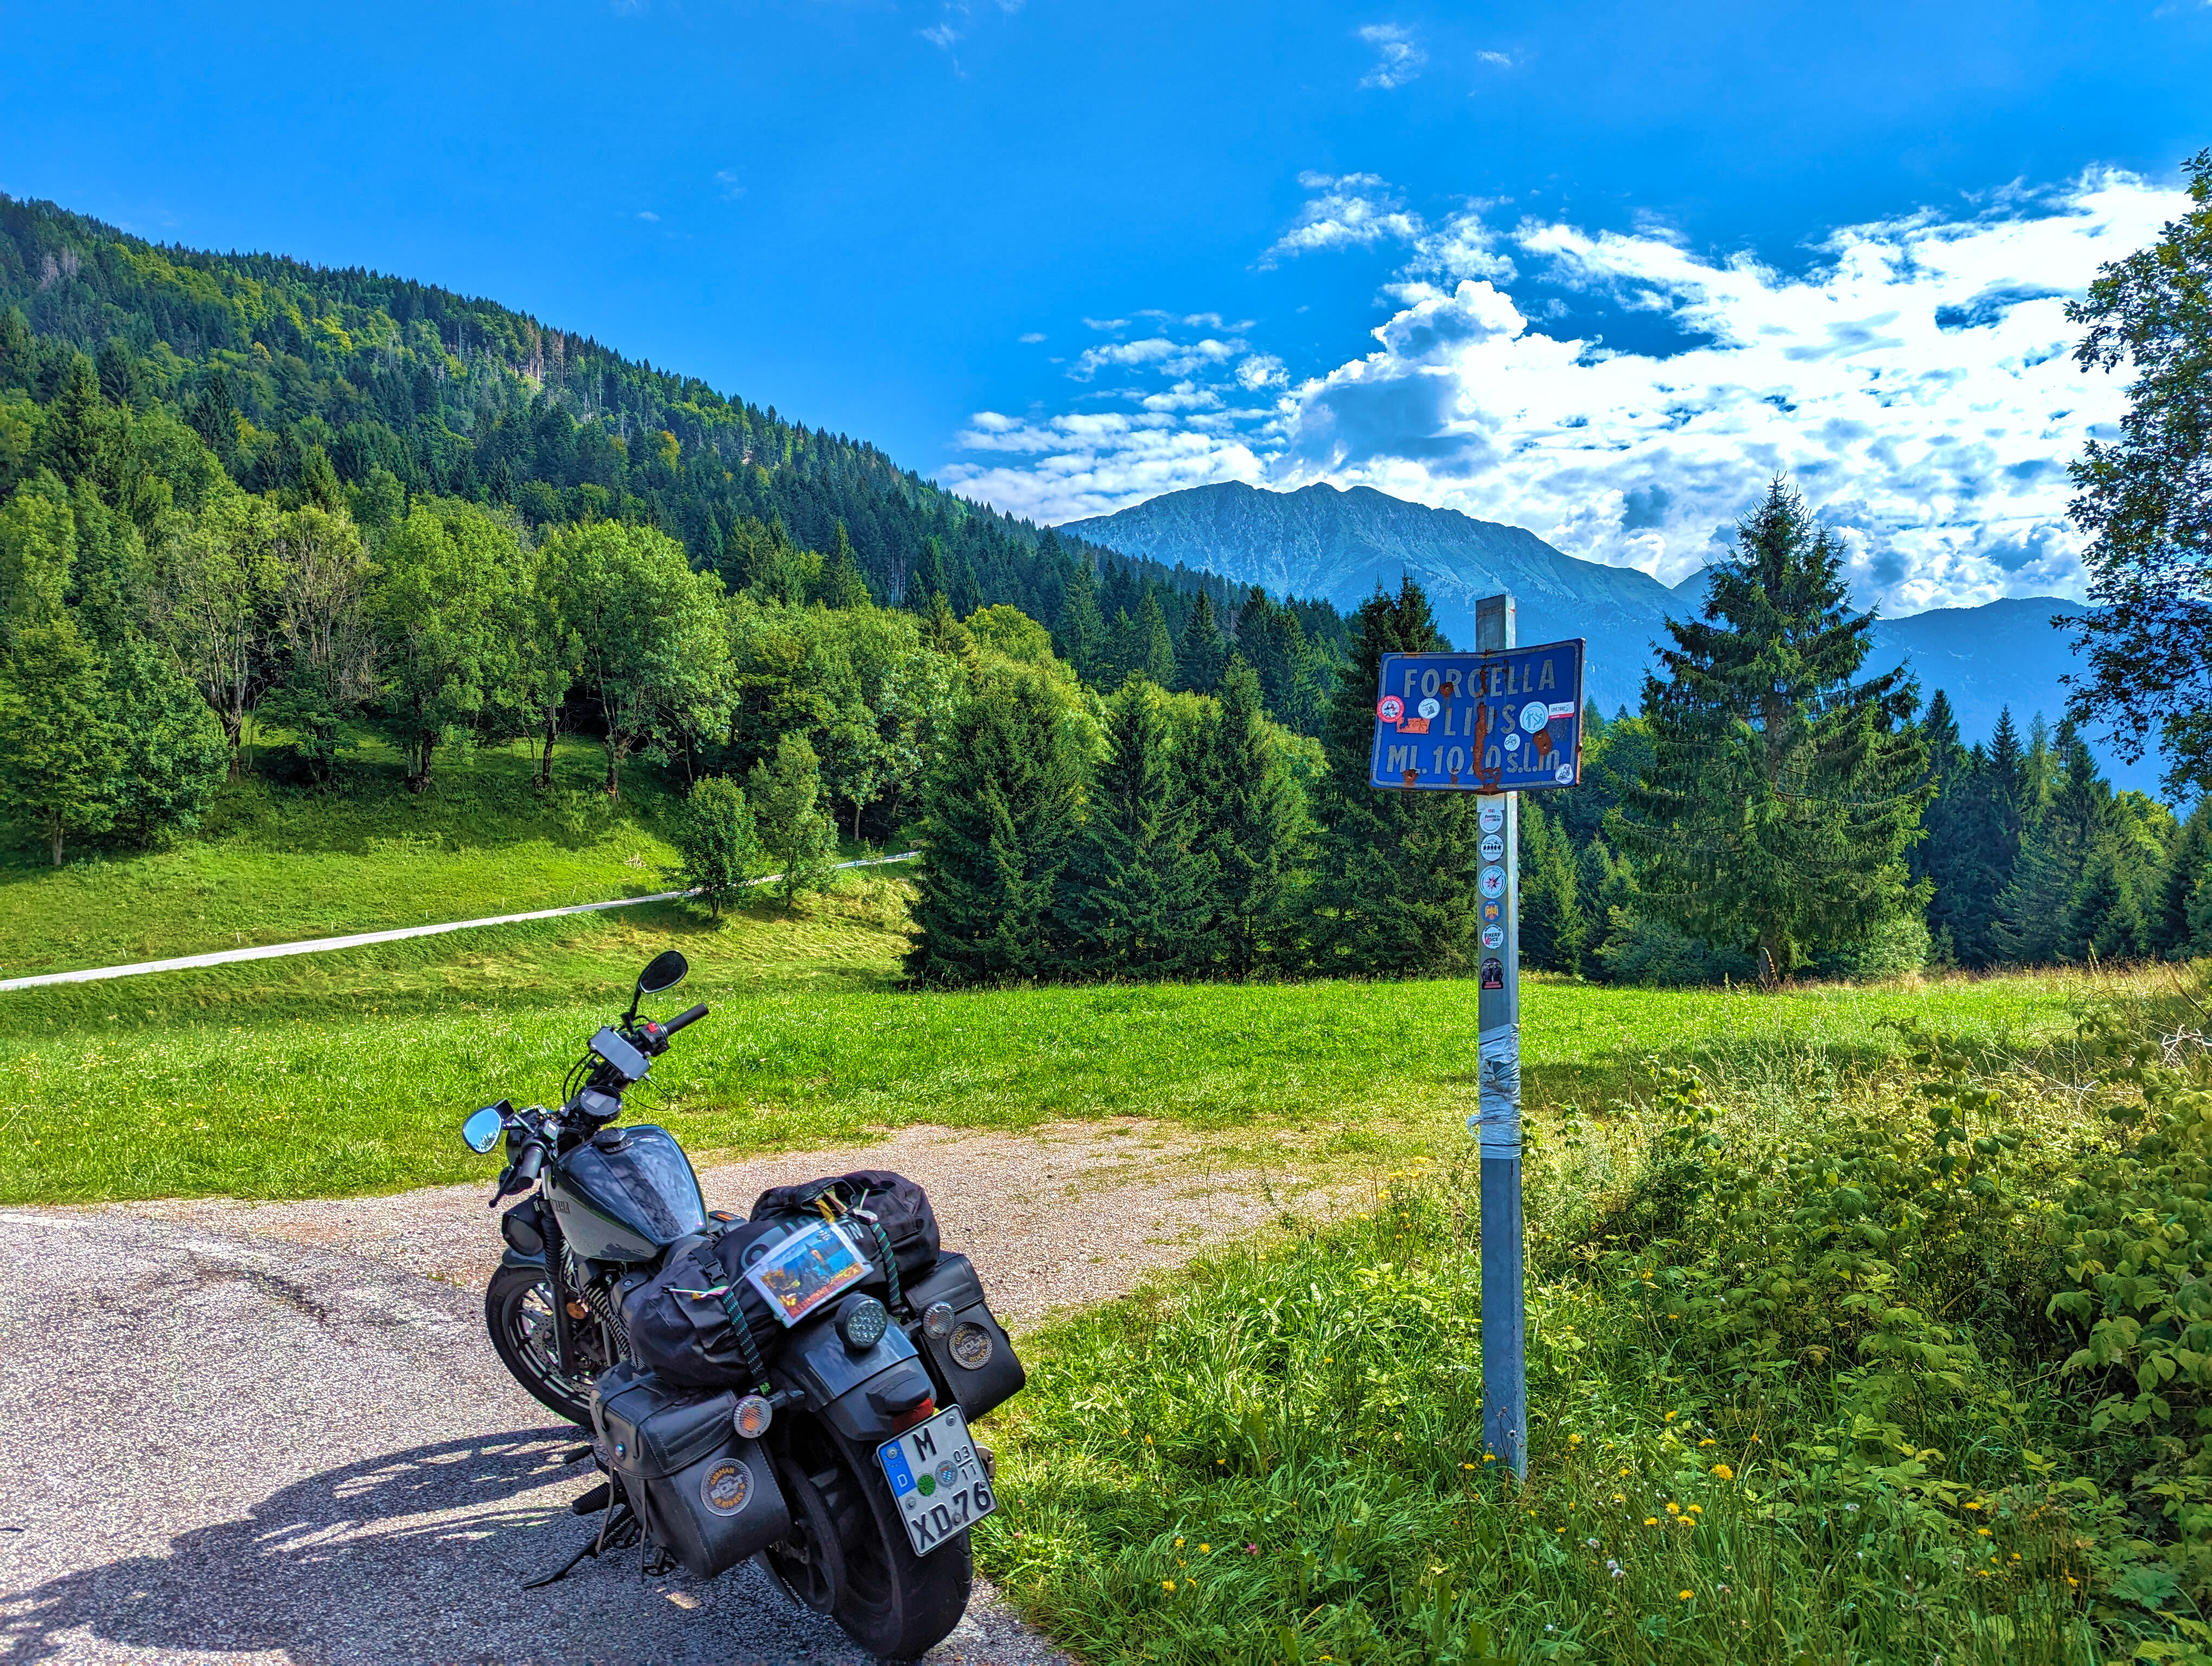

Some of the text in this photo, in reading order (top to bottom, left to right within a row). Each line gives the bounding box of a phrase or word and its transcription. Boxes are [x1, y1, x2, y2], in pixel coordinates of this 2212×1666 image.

[1403, 659, 1555, 698] FORCELLA
[957, 1334, 983, 1355] BOLT
[969, 1348, 987, 1362] RIDERS
[912, 1426, 937, 1462] M
[953, 1445, 970, 1462] 03
[961, 1463, 976, 1480] 11
[896, 1473, 908, 1488] D
